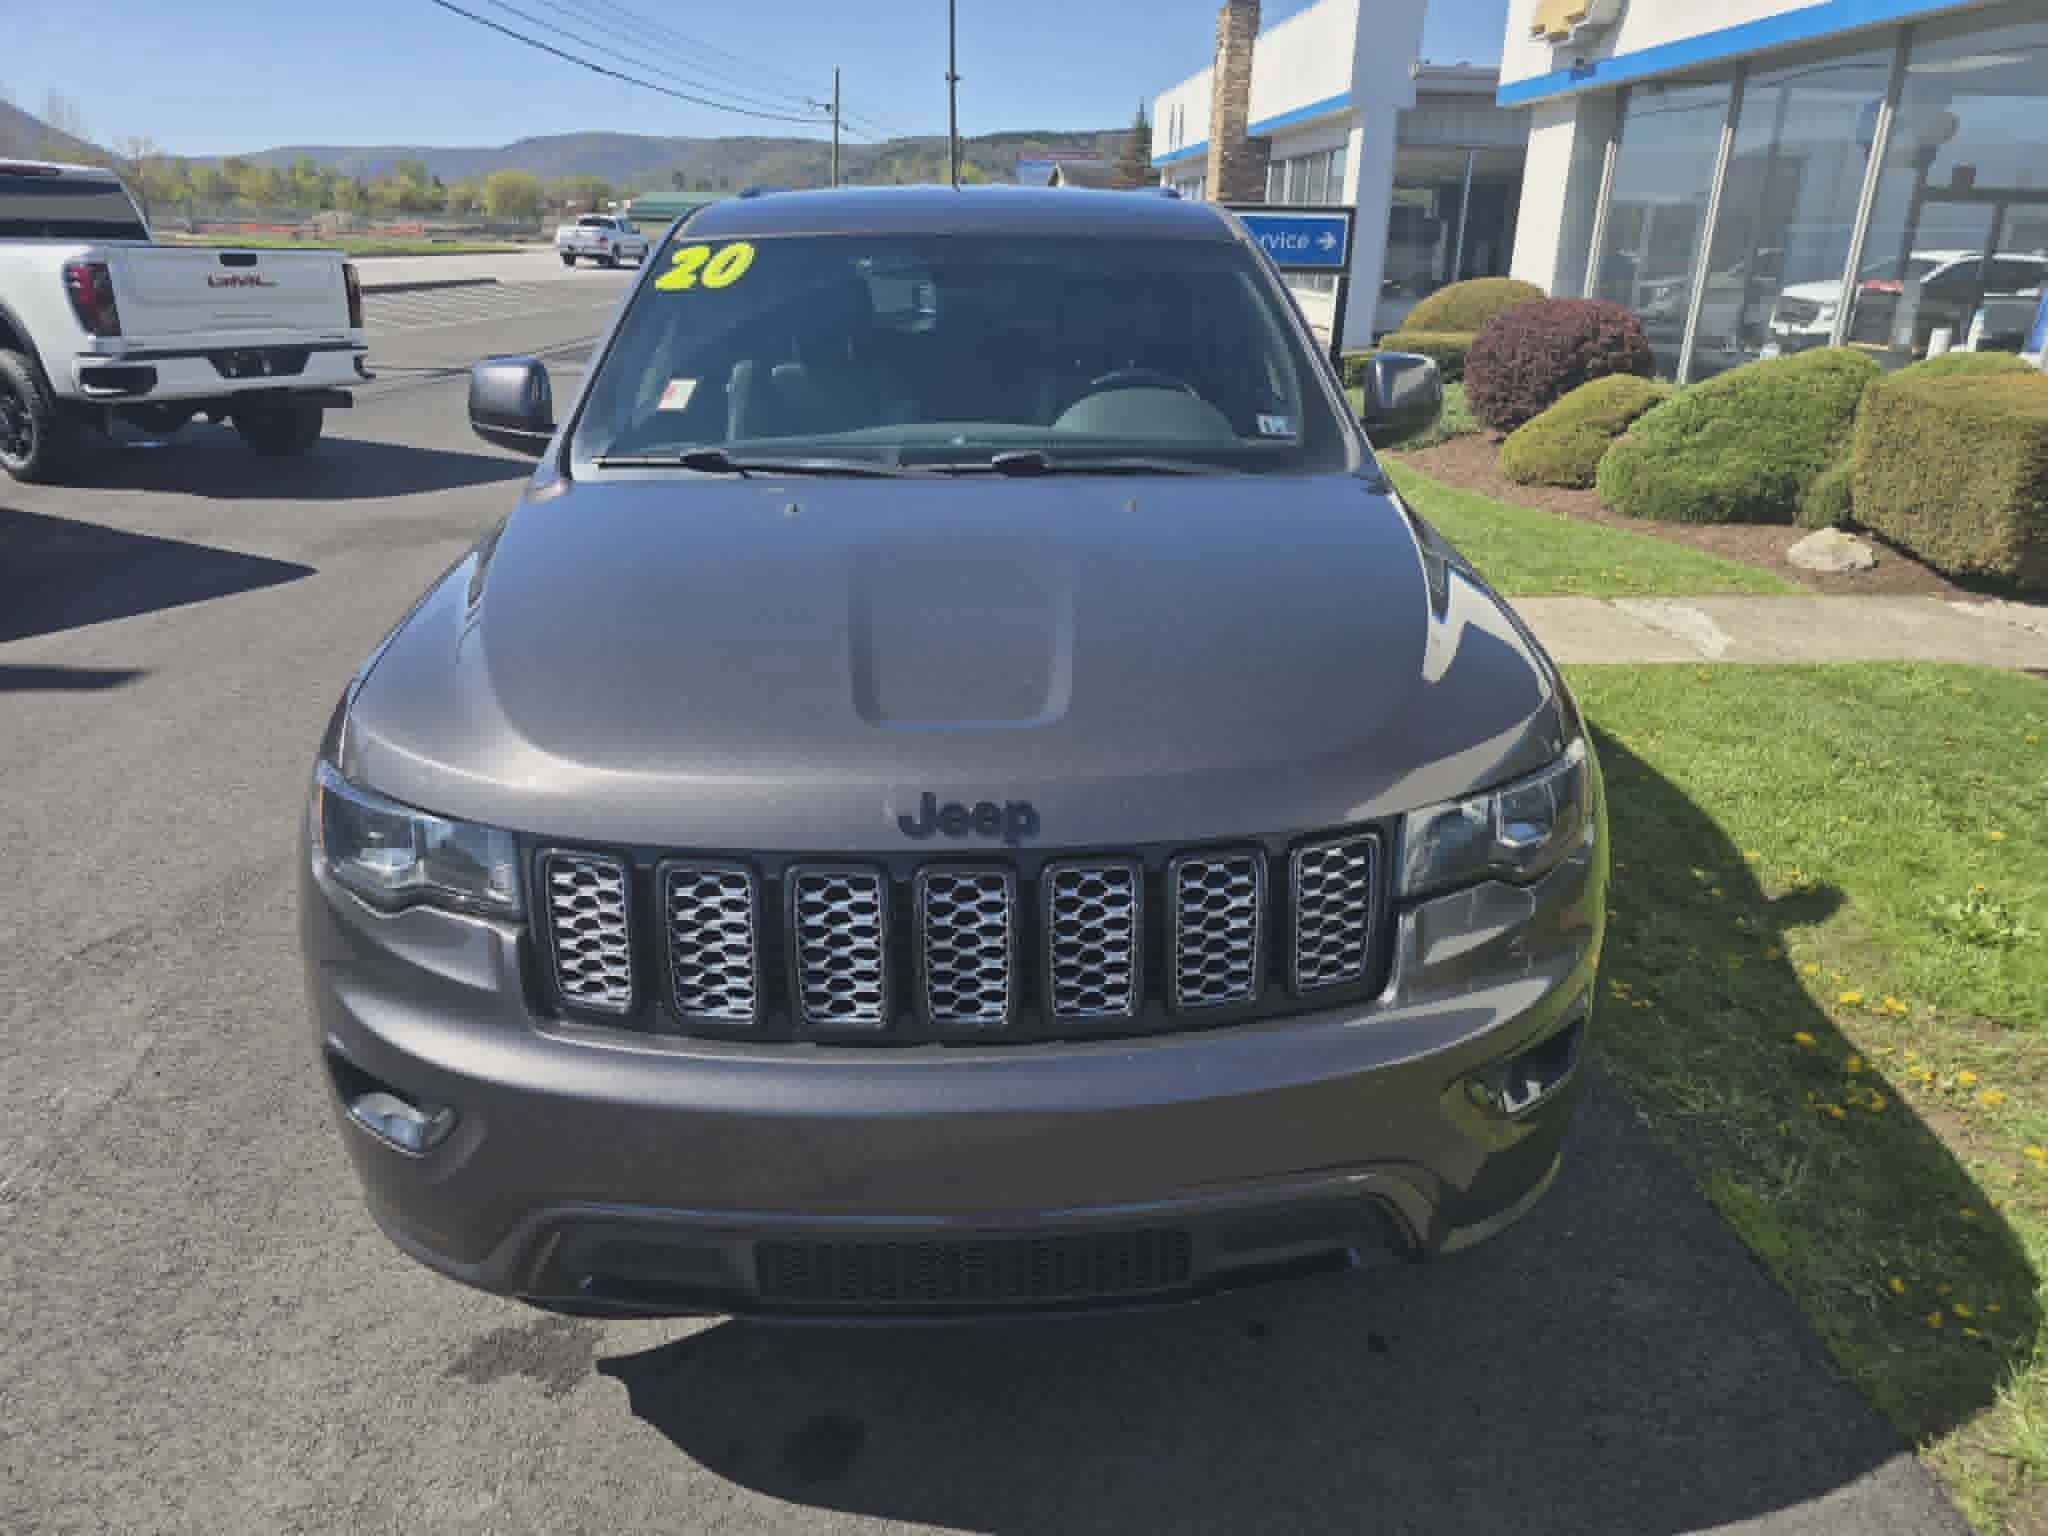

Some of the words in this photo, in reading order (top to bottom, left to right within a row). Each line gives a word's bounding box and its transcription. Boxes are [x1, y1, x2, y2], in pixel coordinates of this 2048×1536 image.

[1256, 231, 1310, 250] rvice
[655, 242, 754, 290] 20
[898, 791, 1040, 847] Jeep
